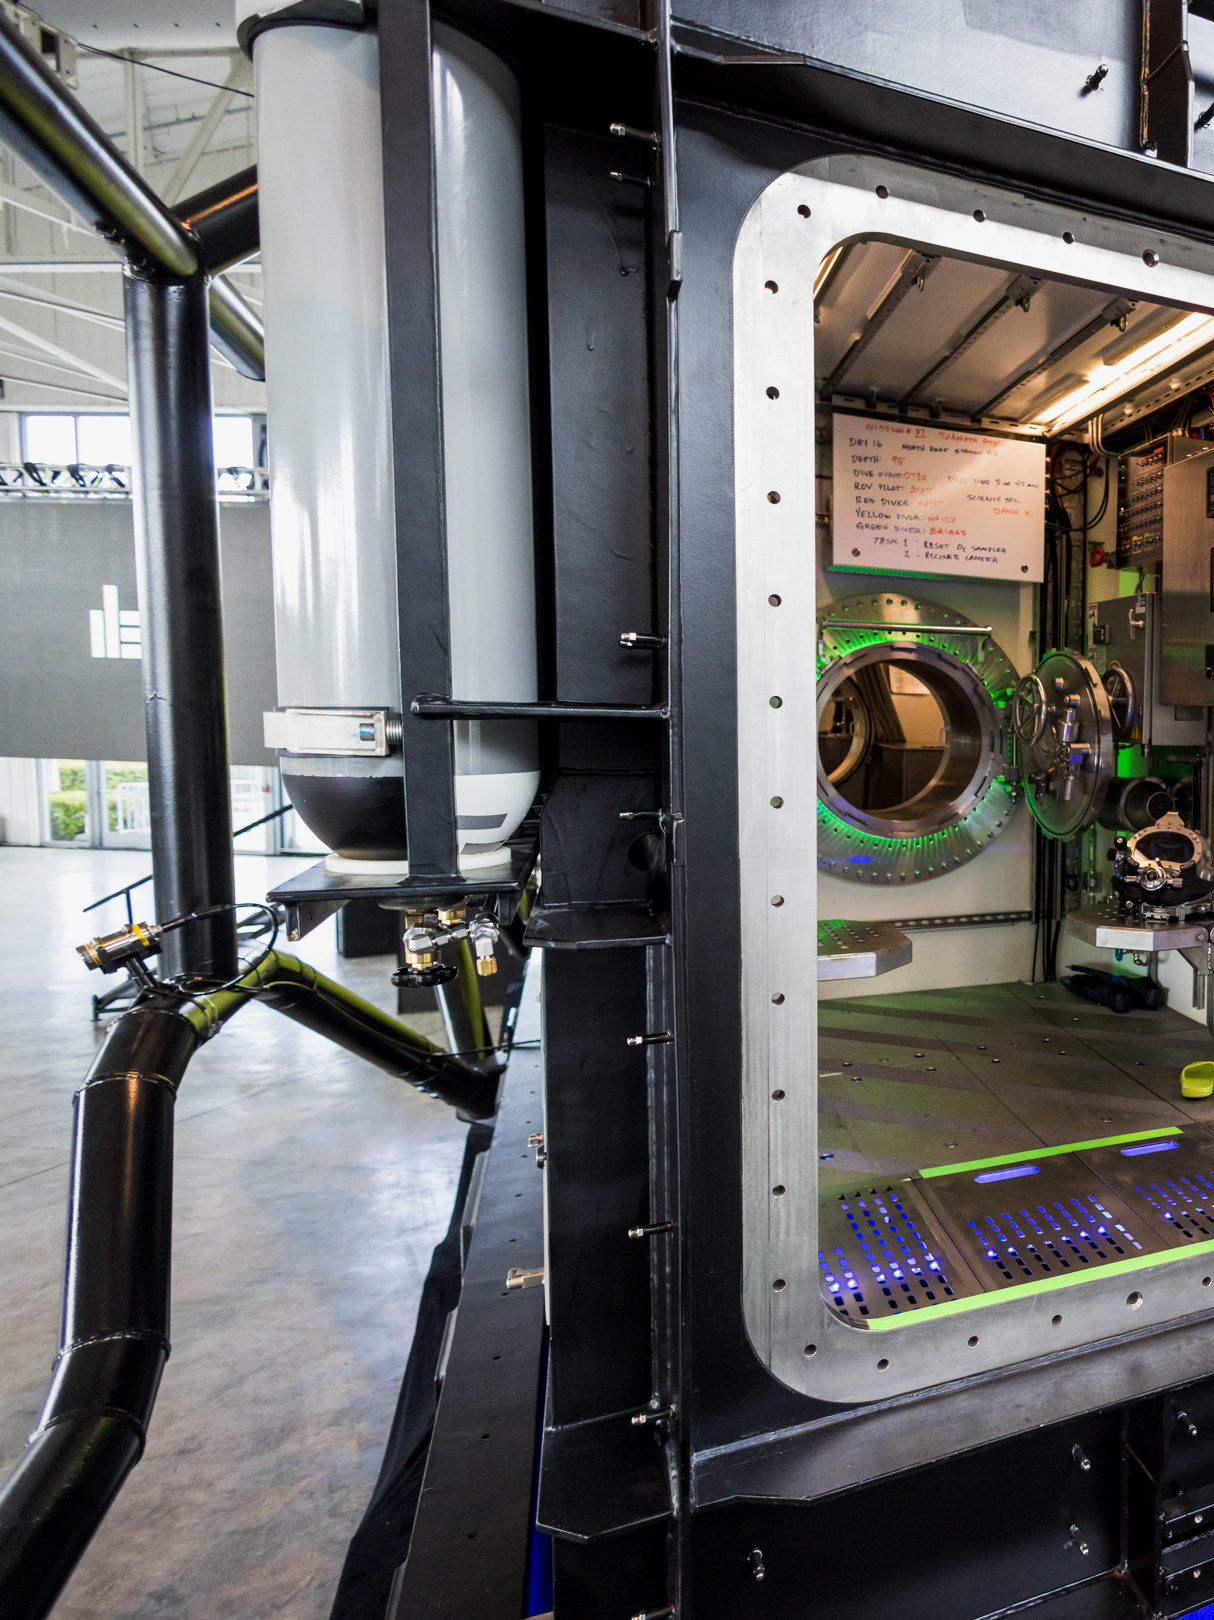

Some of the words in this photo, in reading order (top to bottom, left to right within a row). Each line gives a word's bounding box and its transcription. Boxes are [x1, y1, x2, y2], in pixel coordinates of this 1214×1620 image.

[849, 437, 868, 447] DAY
[873, 438, 882, 448] 16
[901, 443, 925, 452] NORTH
[852, 454, 882, 464] DEPTH:
[853, 469, 874, 478] DIVE
[904, 471, 927, 482] 0730
[854, 482, 873, 491] ROV
[878, 483, 905, 492] PILOT:
[972, 478, 990, 486] TIME
[994, 478, 1001, 486] 3
[1015, 479, 1026, 487] 45
[855, 495, 875, 504] RED
[881, 498, 913, 507] DIVER:
[966, 494, 1001, 502] SCIENCE
[855, 507, 891, 519] YELLOW
[993, 507, 1019, 515] DAWN
[855, 521, 889, 531] GREEN
[894, 525, 926, 535] DIVER:
[929, 527, 967, 536] BRIGGS
[873, 537, 899, 546] TASK
[903, 538, 908, 547] 1
[923, 540, 950, 550] RESET
[971, 545, 1007, 554] SAMPLER
[904, 550, 911, 558] 2
[925, 551, 960, 561] RECOVER
[965, 554, 998, 564] CAMERA
